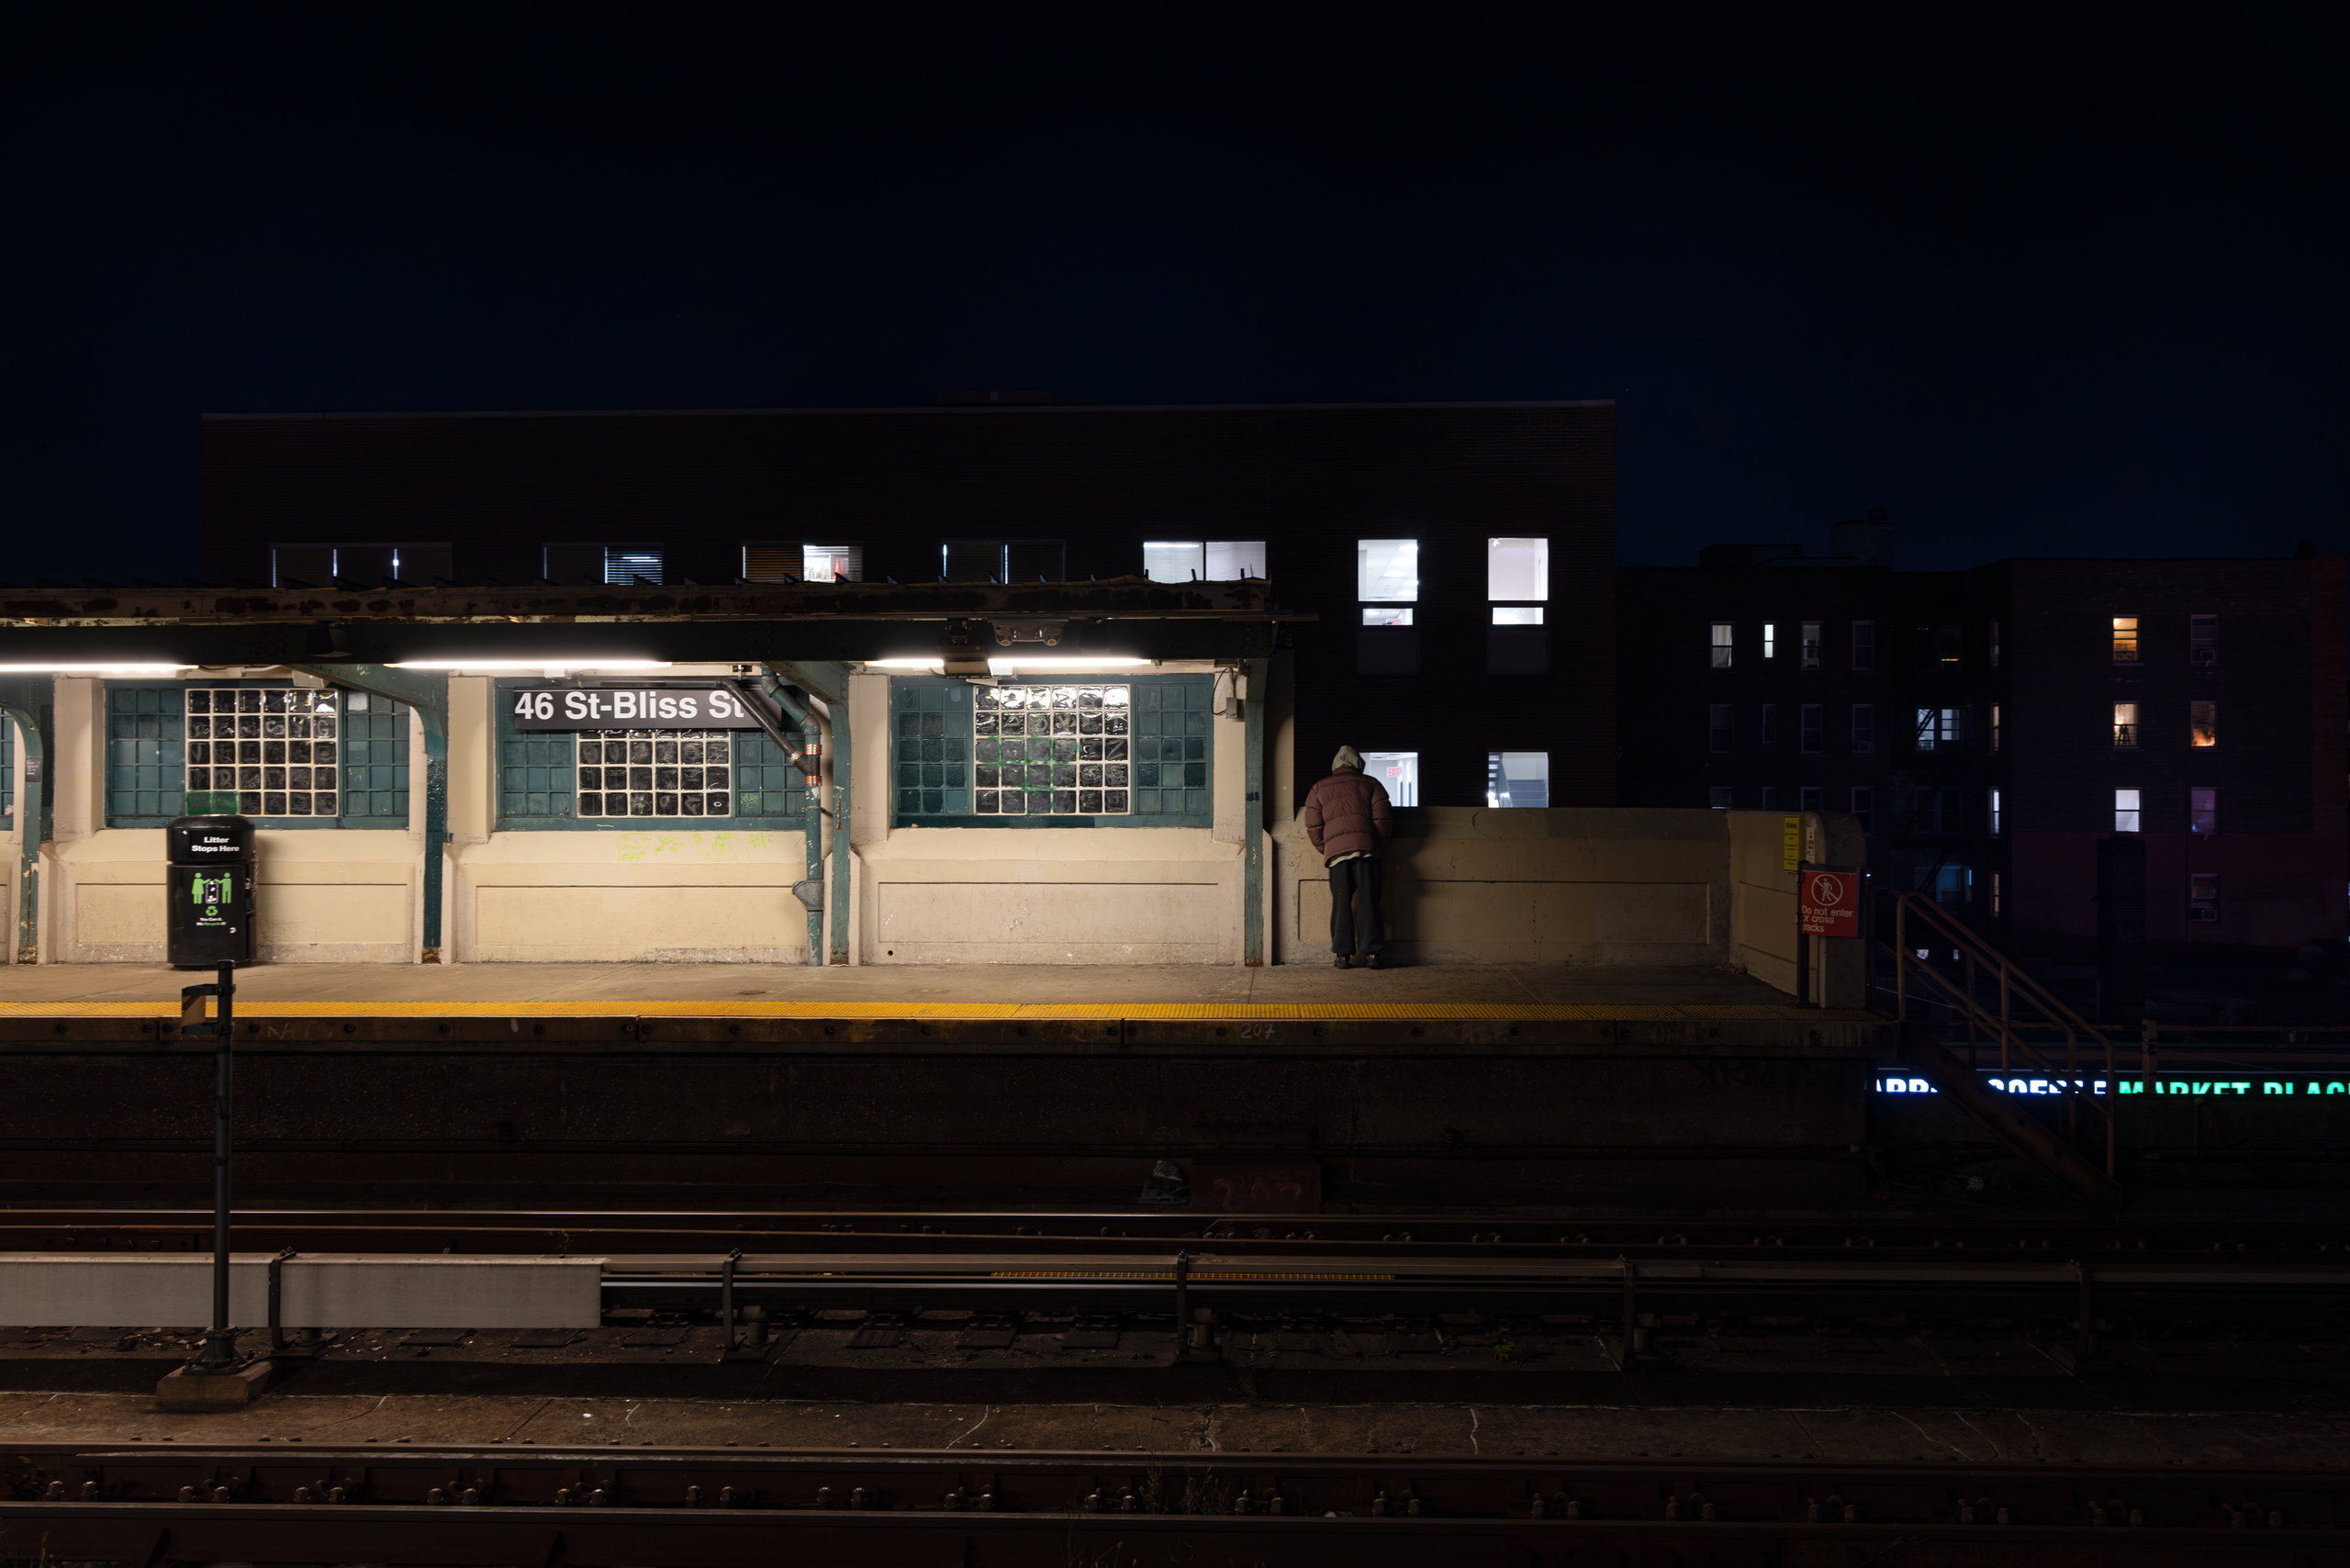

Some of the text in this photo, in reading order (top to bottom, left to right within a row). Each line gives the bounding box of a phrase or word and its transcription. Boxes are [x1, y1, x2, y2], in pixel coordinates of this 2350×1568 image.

[515, 689, 744, 720] 46 St-Bliss St
[191, 845, 218, 853] Stops
[1802, 905, 1853, 918] Do not enter
[1811, 915, 1835, 924] cross
[1803, 924, 1825, 933] racks
[2263, 1081, 2350, 1095] PLAC
